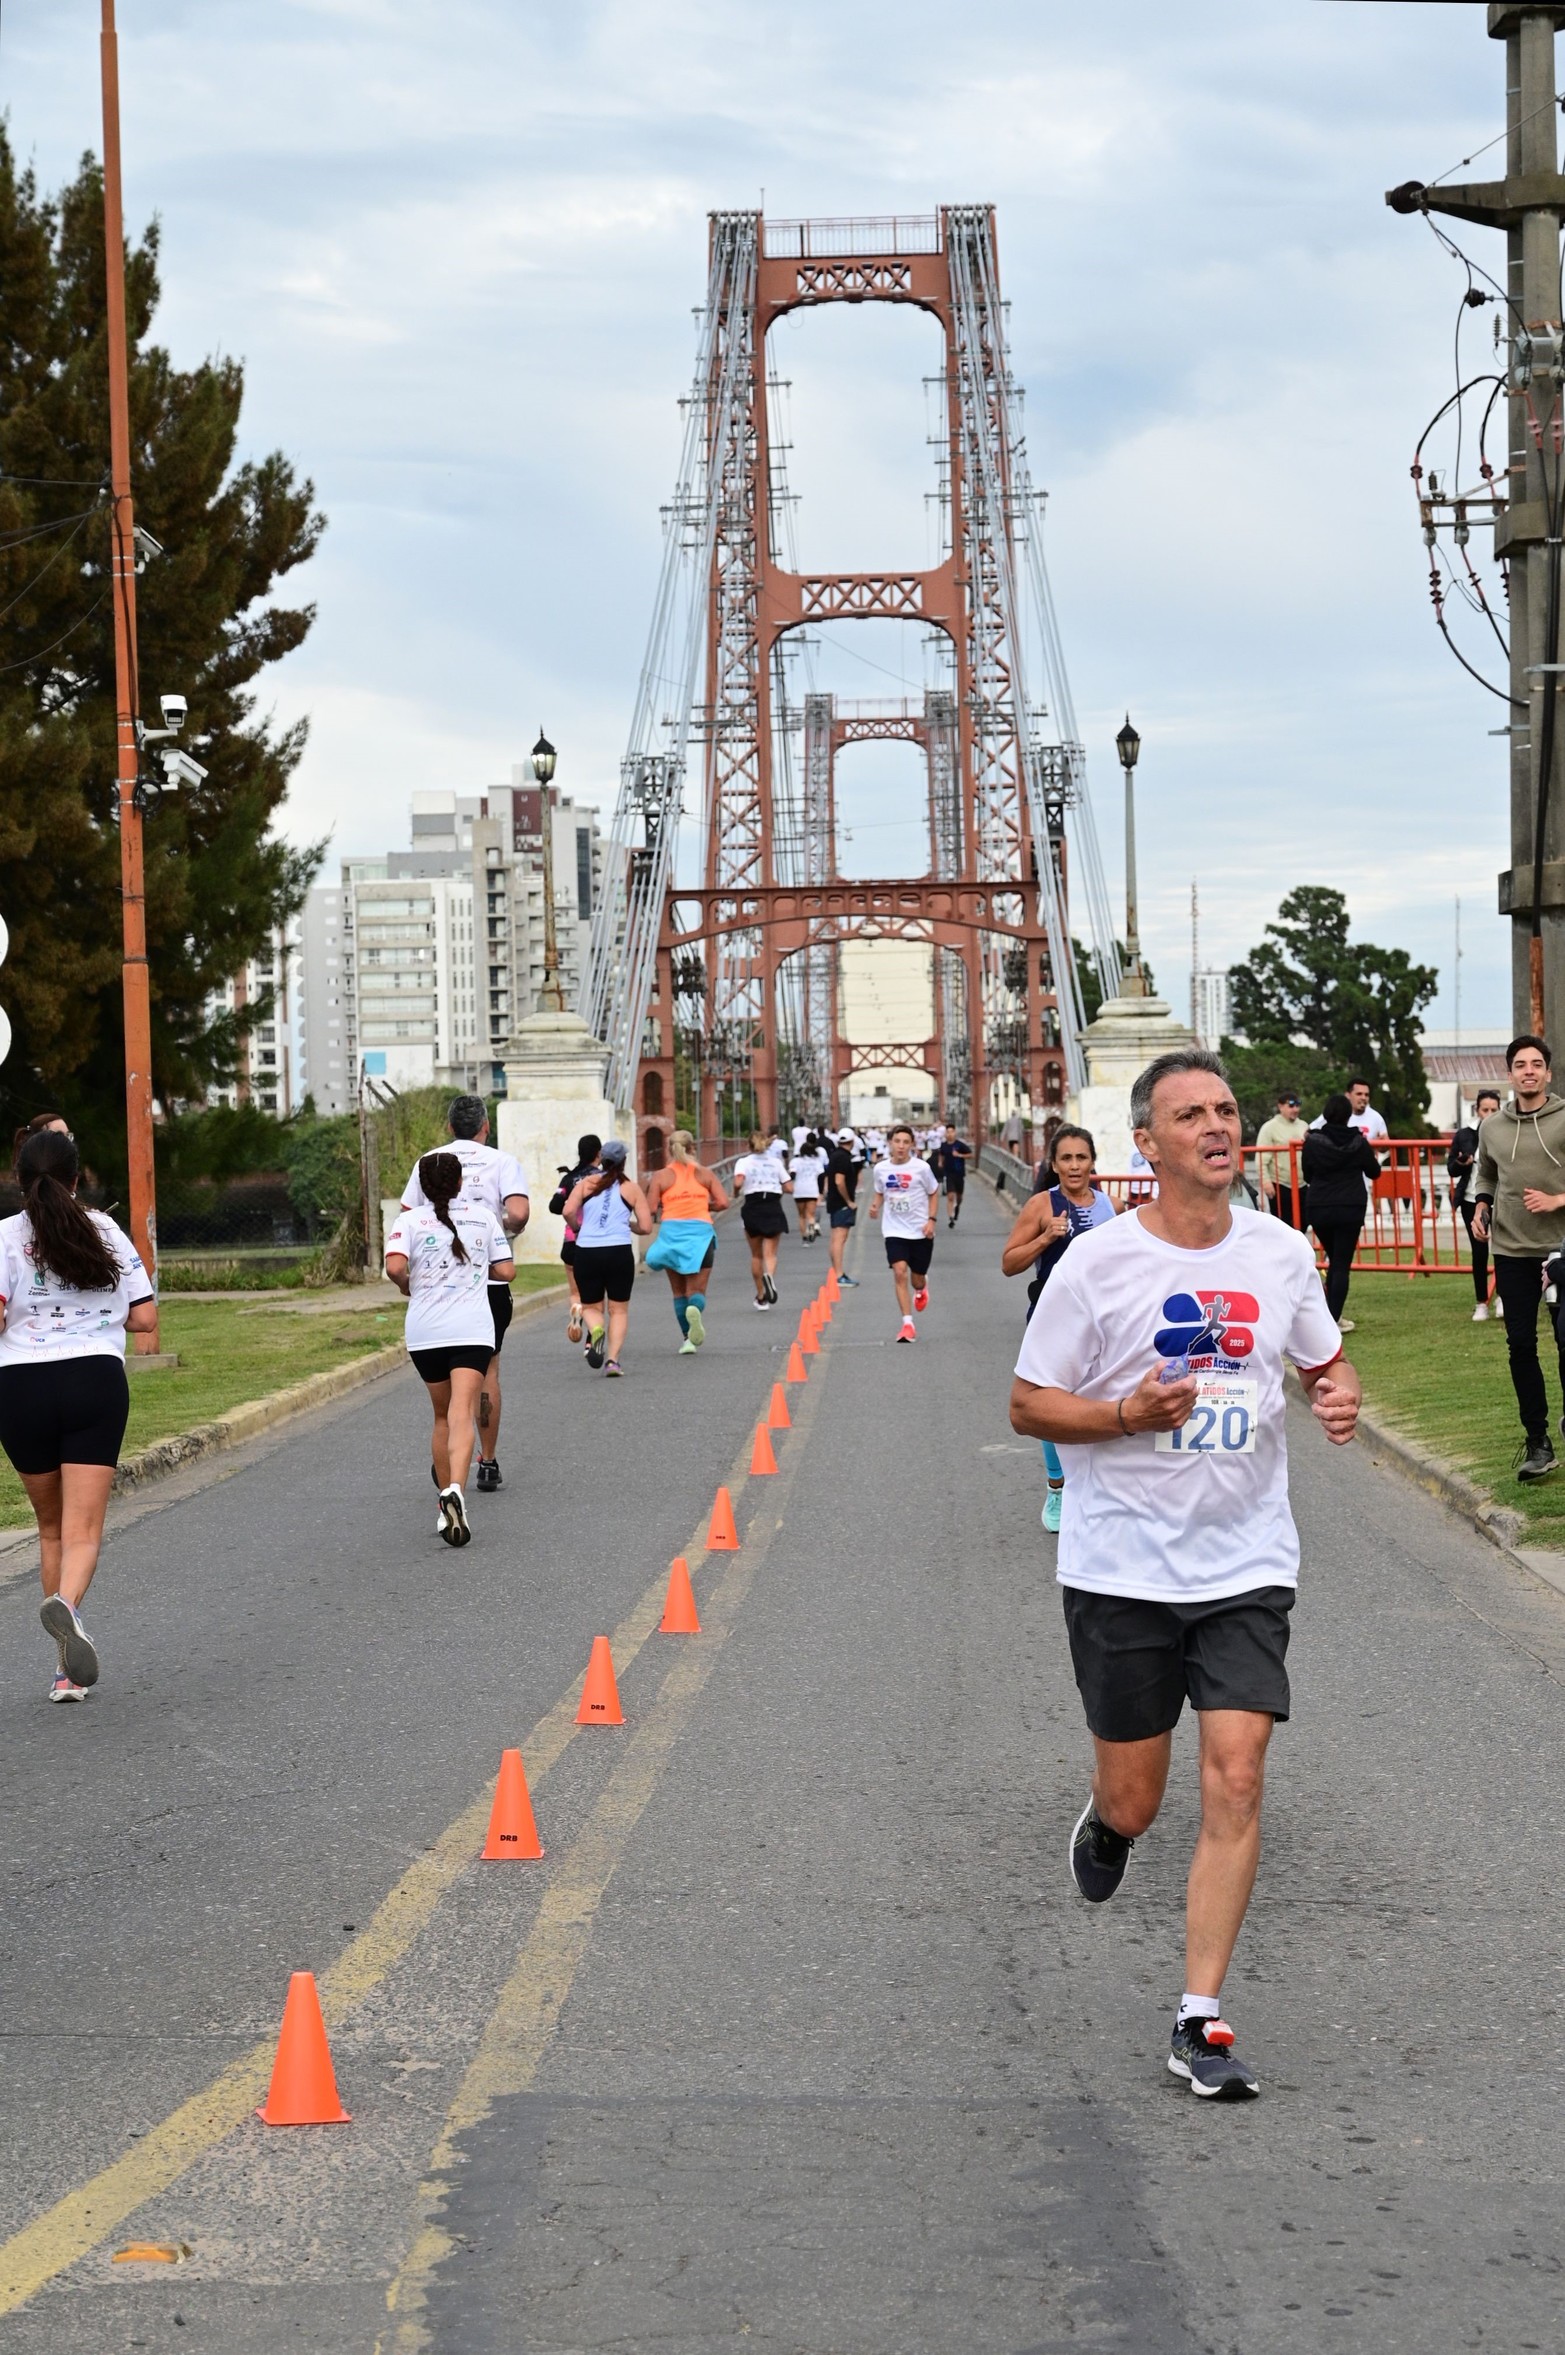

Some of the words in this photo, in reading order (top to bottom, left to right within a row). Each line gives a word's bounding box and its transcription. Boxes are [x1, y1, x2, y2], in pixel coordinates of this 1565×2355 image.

[1230, 1338, 1244, 1346] 2025
[1188, 1356, 1212, 1369] TIDOS
[1172, 1407, 1249, 1450] 120
